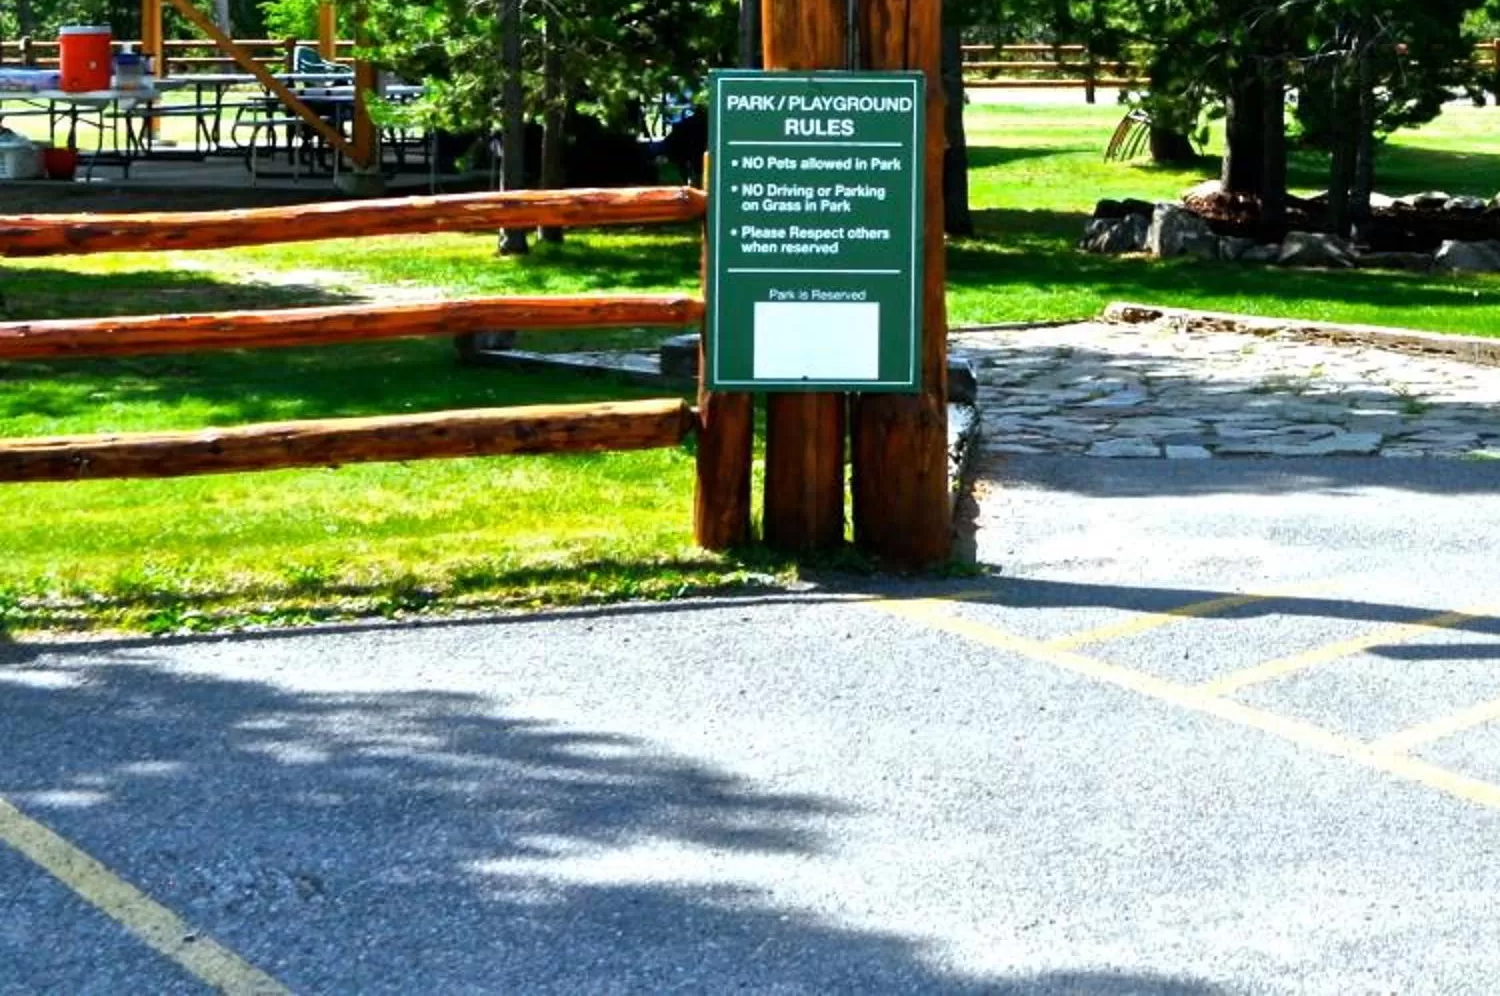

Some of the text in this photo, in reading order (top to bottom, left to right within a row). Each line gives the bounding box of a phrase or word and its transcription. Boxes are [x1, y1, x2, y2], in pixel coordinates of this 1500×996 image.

[727, 95, 775, 111] PARK
[788, 96, 913, 112] PLAYGROUND
[784, 118, 855, 136] RULES
[742, 156, 902, 171] NO Pets allowed in Park
[742, 183, 886, 200] NO Driving or Parking
[741, 199, 851, 212] on Grass in Park
[741, 225, 890, 241] Please Respect others
[741, 241, 839, 253] when reserved
[769, 288, 867, 301] Park is Reserved
